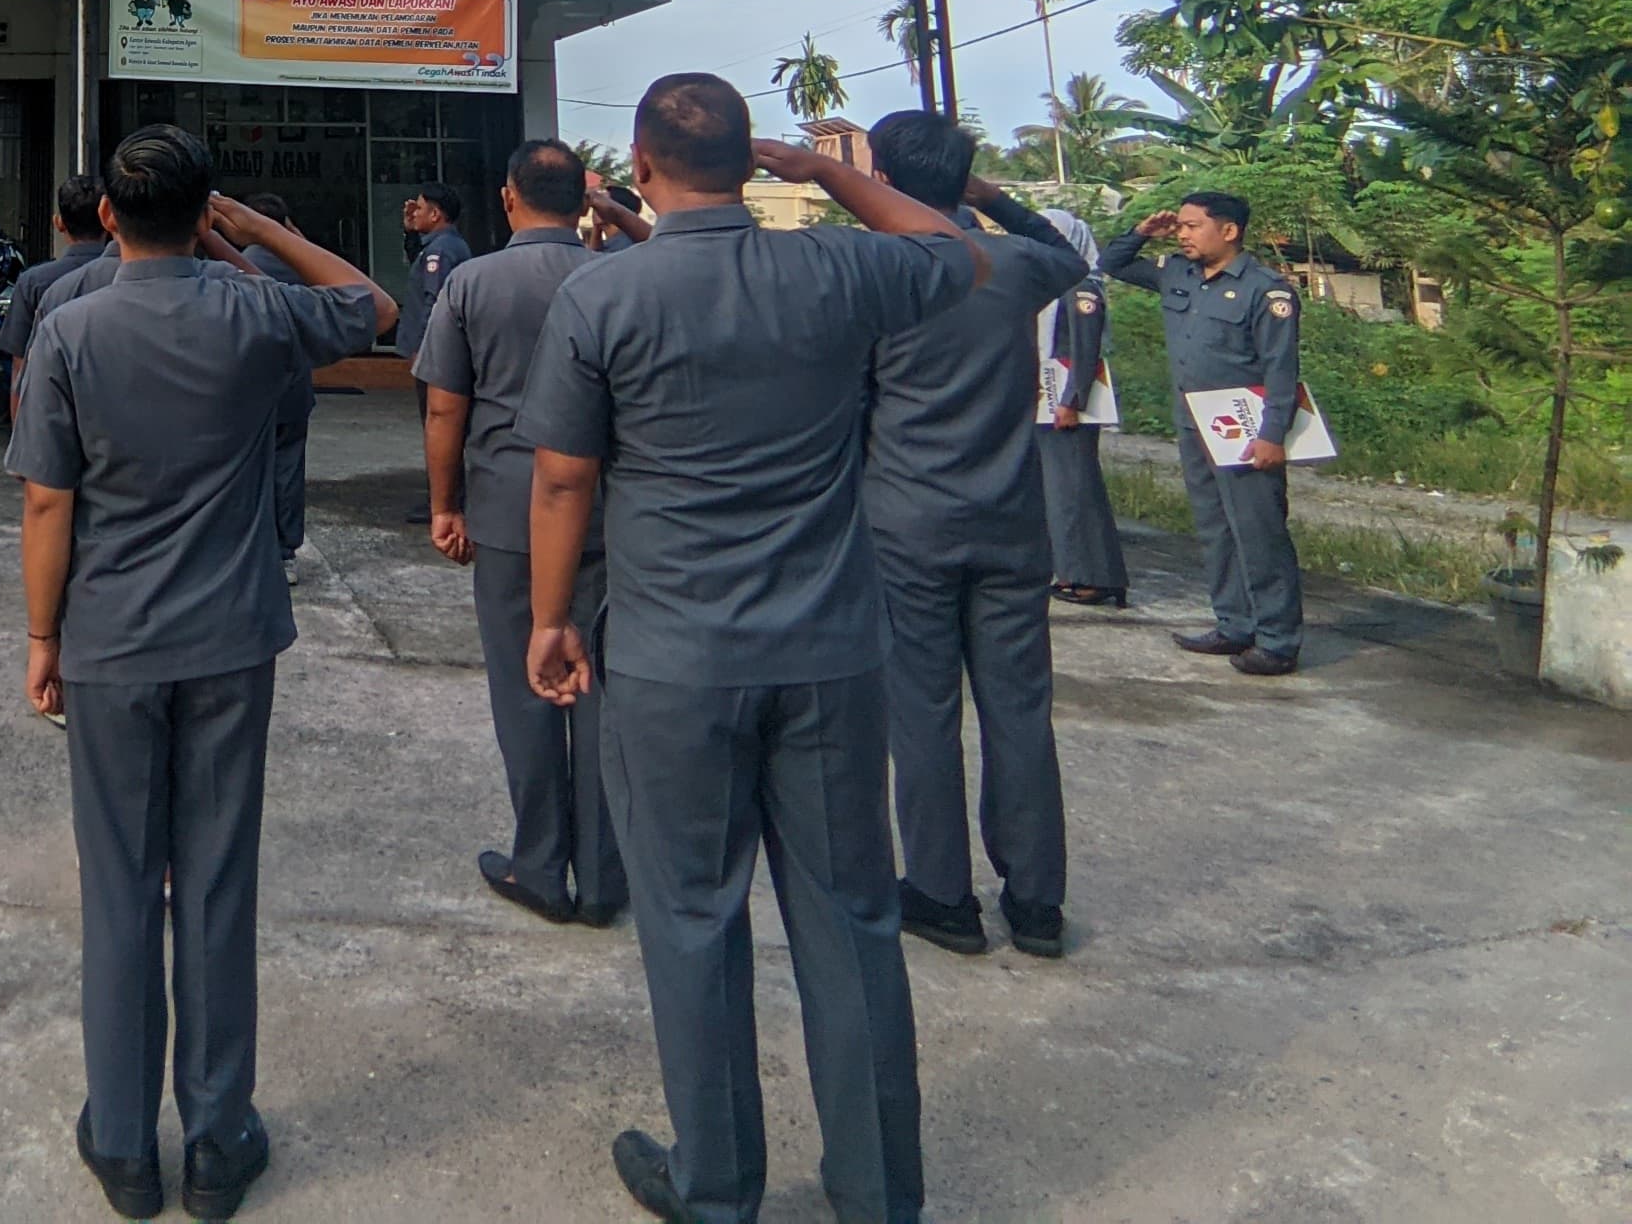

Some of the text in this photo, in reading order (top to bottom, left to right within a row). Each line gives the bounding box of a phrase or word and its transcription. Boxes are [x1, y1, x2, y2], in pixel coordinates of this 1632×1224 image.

[311, 12, 436, 22] JIKA MENEMUKAN PELANGGARAN
[292, 24, 454, 36] MAUPUN PERUBAHAN DATA PEMILIH PADA
[265, 35, 479, 49] PROSES PEMUTAKHIRAN DATA PEMILIH BERKELANJUTAN
